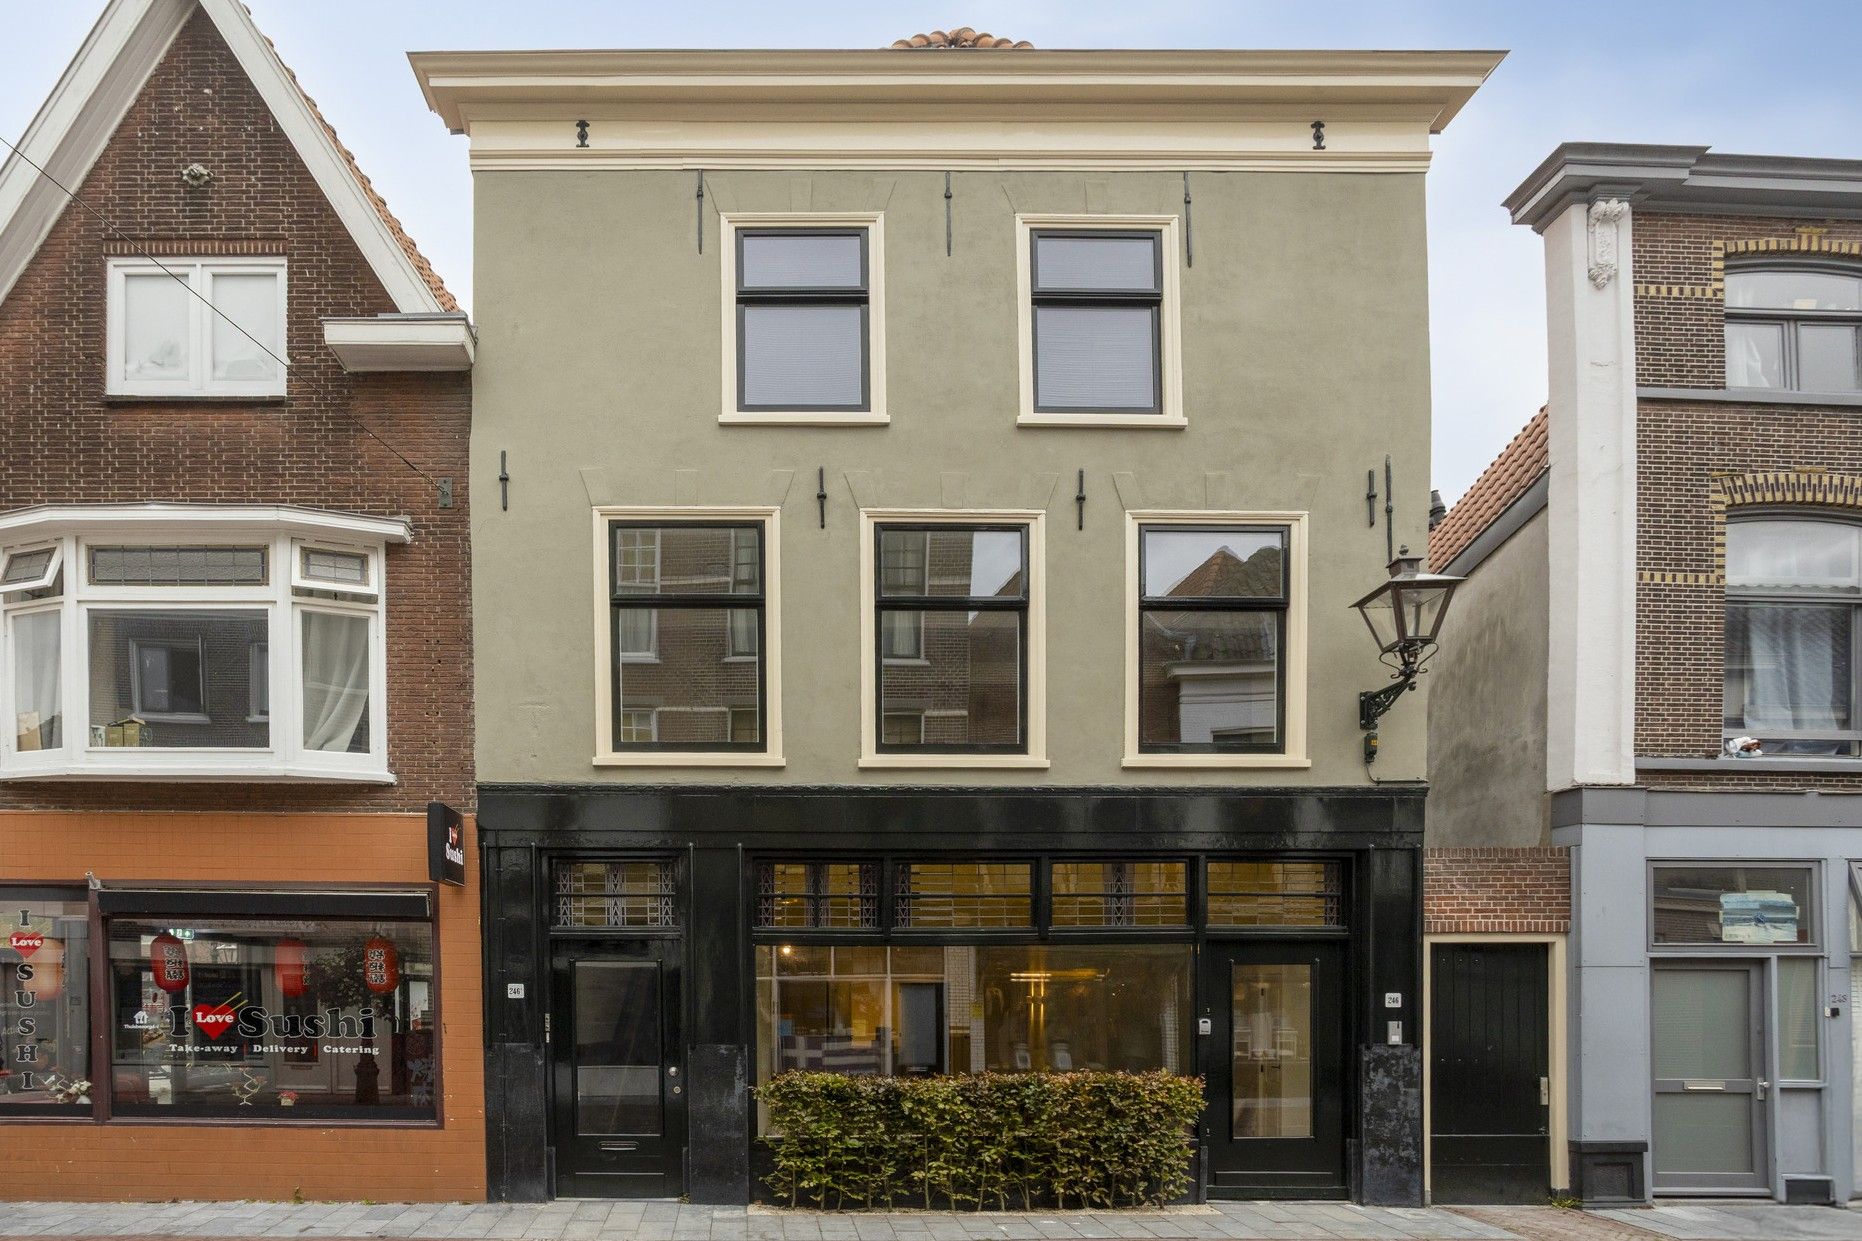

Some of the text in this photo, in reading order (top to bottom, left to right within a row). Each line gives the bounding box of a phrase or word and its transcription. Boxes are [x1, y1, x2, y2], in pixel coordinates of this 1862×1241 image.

[445, 842, 463, 866] Sushi
[19, 909, 31, 927] I
[11, 938, 41, 947] Love
[169, 1006, 377, 1038] I Love Sushi
[168, 1043, 238, 1054] Take-away
[253, 1044, 308, 1055] Delivery
[323, 1045, 380, 1056] Catering
